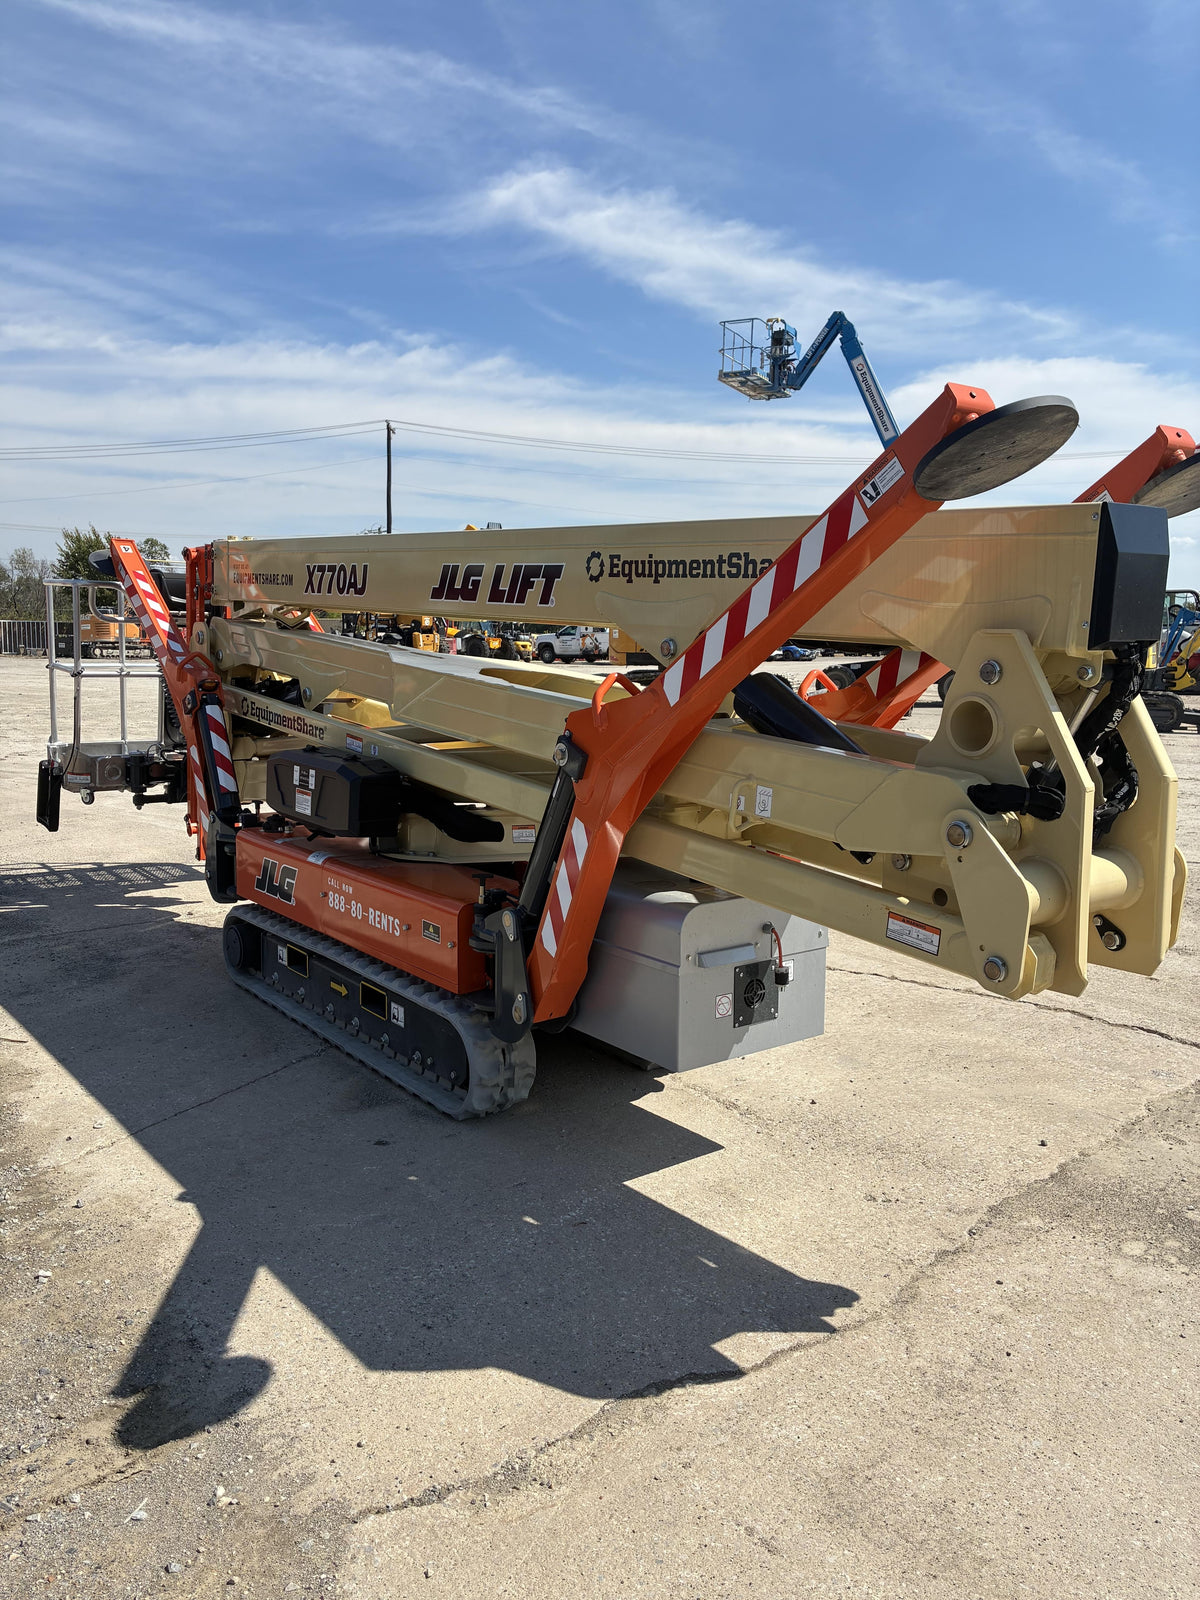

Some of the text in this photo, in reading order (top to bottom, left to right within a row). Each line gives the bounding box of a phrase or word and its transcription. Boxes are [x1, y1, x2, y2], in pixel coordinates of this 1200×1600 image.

[860, 371, 889, 433] EquipmentShare
[233, 572, 294, 586] EQUIPMENTSHARE.COM
[304, 563, 368, 597] X770AJ
[429, 563, 565, 607] JLG LIFT
[608, 552, 774, 584] EquipmentSha
[250, 701, 325, 740] EquipmentShare
[254, 856, 299, 906] JLG
[328, 877, 353, 895] CALL NOW
[328, 891, 400, 937] 888-80-RENTS
